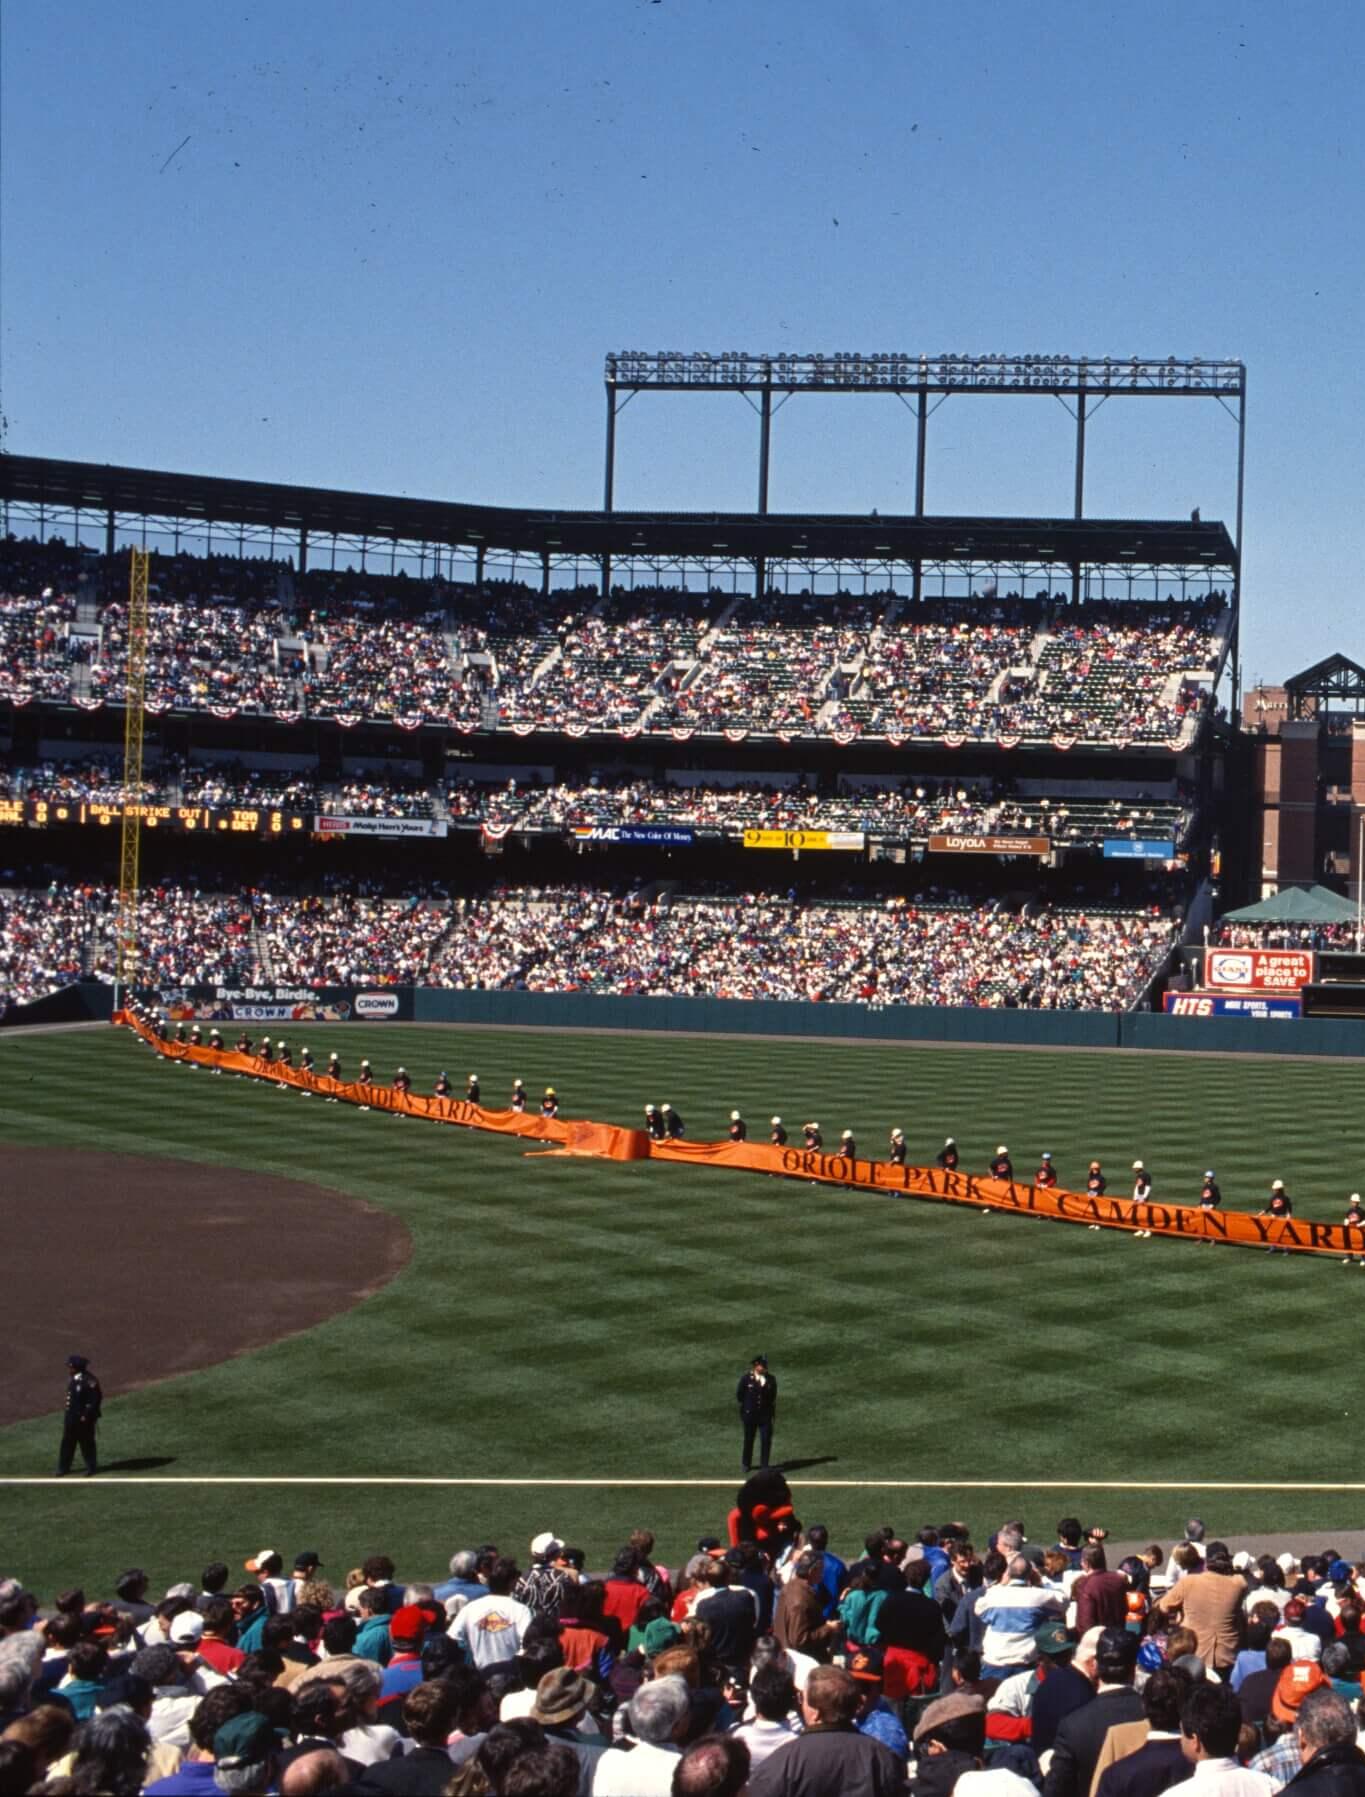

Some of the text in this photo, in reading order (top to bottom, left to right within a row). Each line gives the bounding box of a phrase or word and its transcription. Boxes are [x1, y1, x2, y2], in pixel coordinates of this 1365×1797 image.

[90, 804, 201, 819] BALL STRIKE OUT
[232, 811, 258, 821] TOR
[231, 821, 257, 831] DET
[590, 828, 620, 840] MAC
[1258, 955, 1304, 968] A great
[1255, 967, 1307, 977] place to
[1264, 977, 1297, 986] SAVE
[216, 987, 320, 1001] Bye-Bye, Birdie.
[357, 1000, 396, 1009] CROWN
[1172, 999, 1214, 1016] HTS
[234, 1006, 287, 1018] CROWN
[423, 1097, 485, 1122] YARDS
[783, 1149, 882, 1186] ORIOLE
[903, 1166, 983, 1200] PARK
[1003, 1182, 1045, 1209] AT
[1057, 1193, 1229, 1238] CAMDEN
